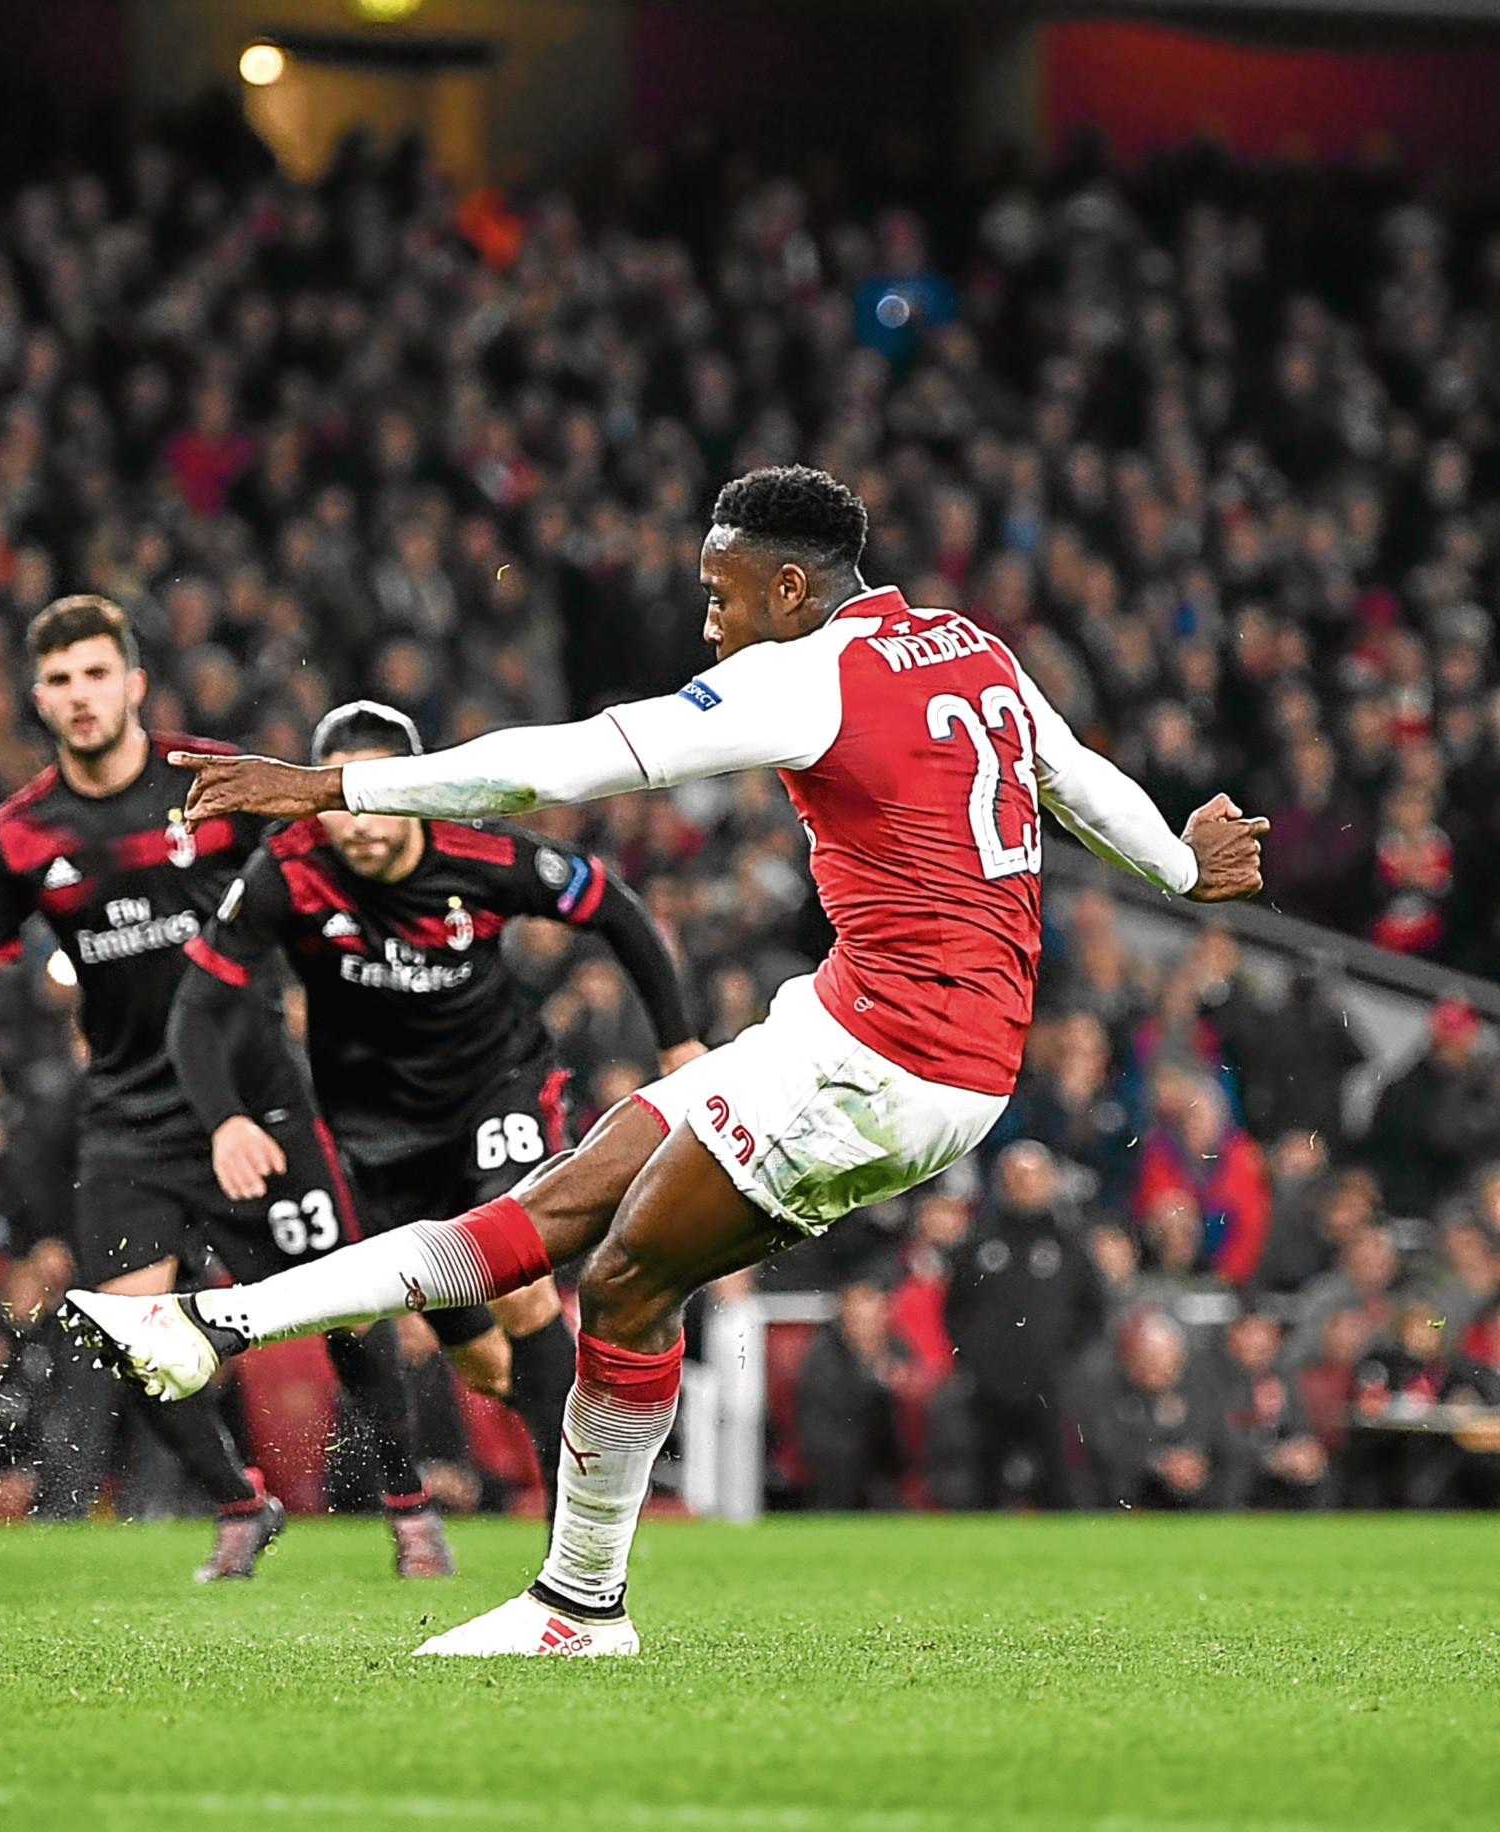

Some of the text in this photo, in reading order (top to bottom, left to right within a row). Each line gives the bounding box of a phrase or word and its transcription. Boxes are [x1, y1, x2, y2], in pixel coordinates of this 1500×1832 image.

[867, 617, 991, 672] WELBEC
[926, 684, 1042, 880] 23
[77, 909, 200, 964] Emirates
[105, 896, 151, 928] Fly
[340, 953, 474, 993] Emirates
[476, 1112, 544, 1170] 68
[267, 1188, 339, 1255] 63
